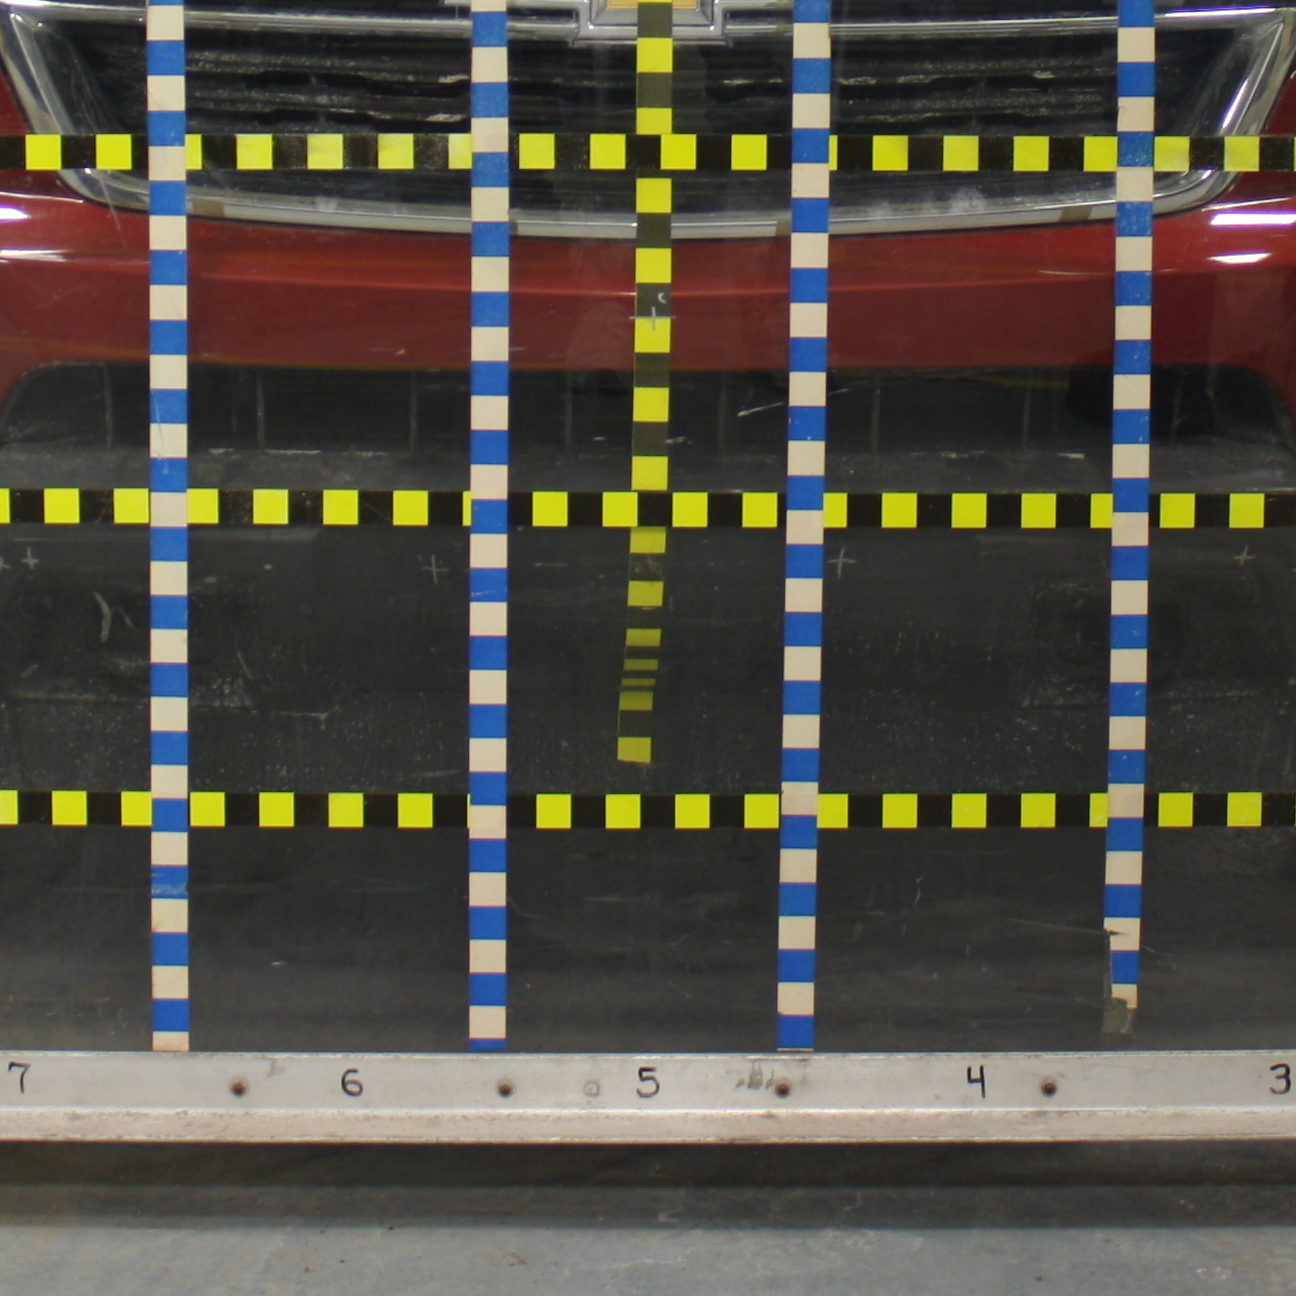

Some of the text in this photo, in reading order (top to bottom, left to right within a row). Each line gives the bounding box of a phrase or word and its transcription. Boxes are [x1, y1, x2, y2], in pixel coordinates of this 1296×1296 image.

[7, 1062, 30, 1094] 7
[341, 1068, 364, 1097] 6
[636, 1067, 661, 1098] 5
[967, 1065, 987, 1099] 4
[1269, 1063, 1292, 1095] 3
